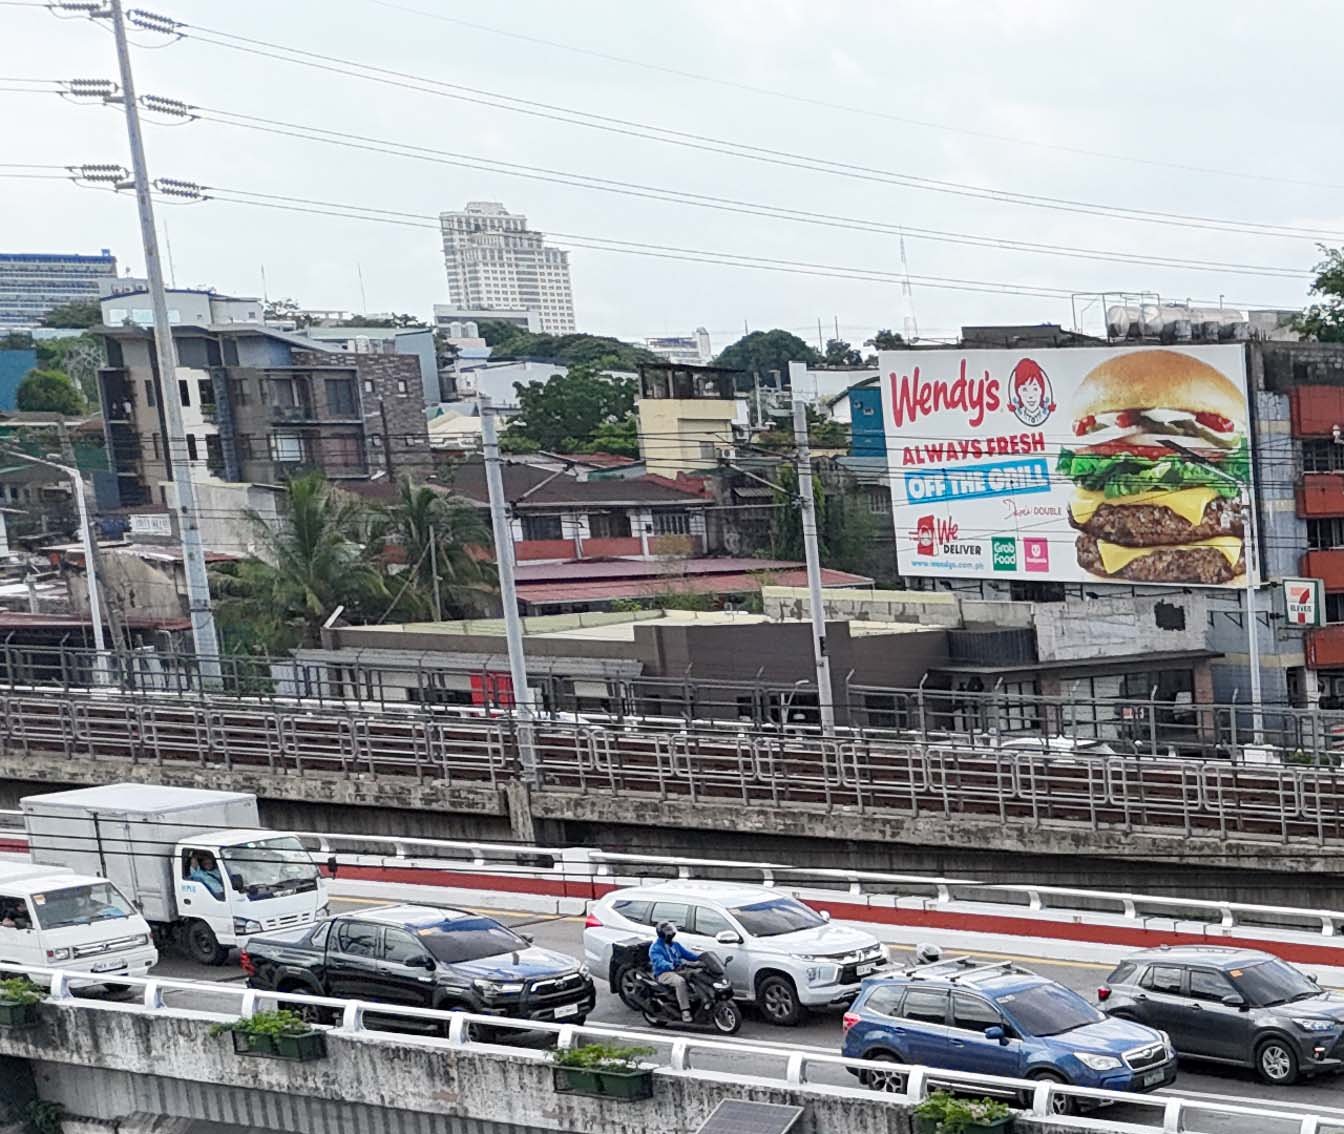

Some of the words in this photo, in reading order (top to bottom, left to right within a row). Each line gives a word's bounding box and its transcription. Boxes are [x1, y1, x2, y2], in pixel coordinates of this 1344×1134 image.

[889, 358, 1001, 427] Wendy's
[902, 439, 983, 466] ALWAYS
[986, 431, 1045, 457] FRESH
[908, 474, 946, 499] OFF
[947, 471, 987, 496] THE
[988, 464, 1050, 491] GRILL
[937, 515, 959, 545] We
[943, 544, 982, 555] DELIVER
[994, 541, 1015, 553] Grab
[994, 552, 1016, 564] Food
